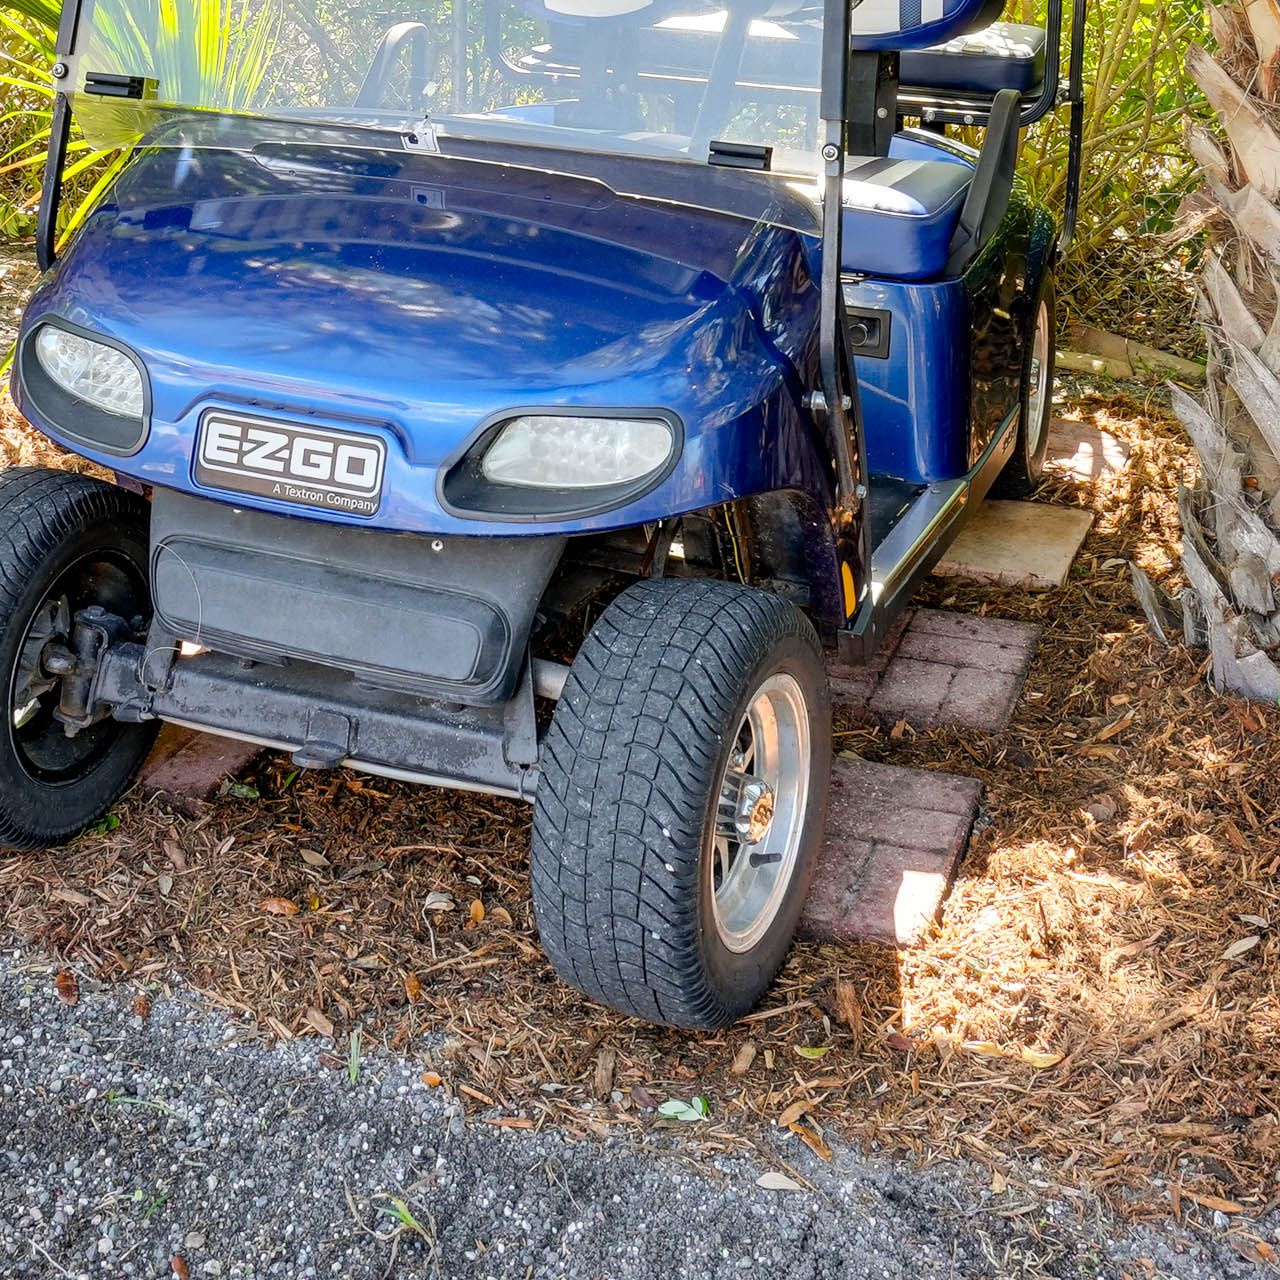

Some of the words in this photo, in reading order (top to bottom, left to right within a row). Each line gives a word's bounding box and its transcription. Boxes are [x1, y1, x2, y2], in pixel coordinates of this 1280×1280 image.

[205, 422, 379, 488] EZGO
[273, 483, 281, 494] A
[284, 485, 323, 501] Textron
[327, 493, 378, 513] Company
